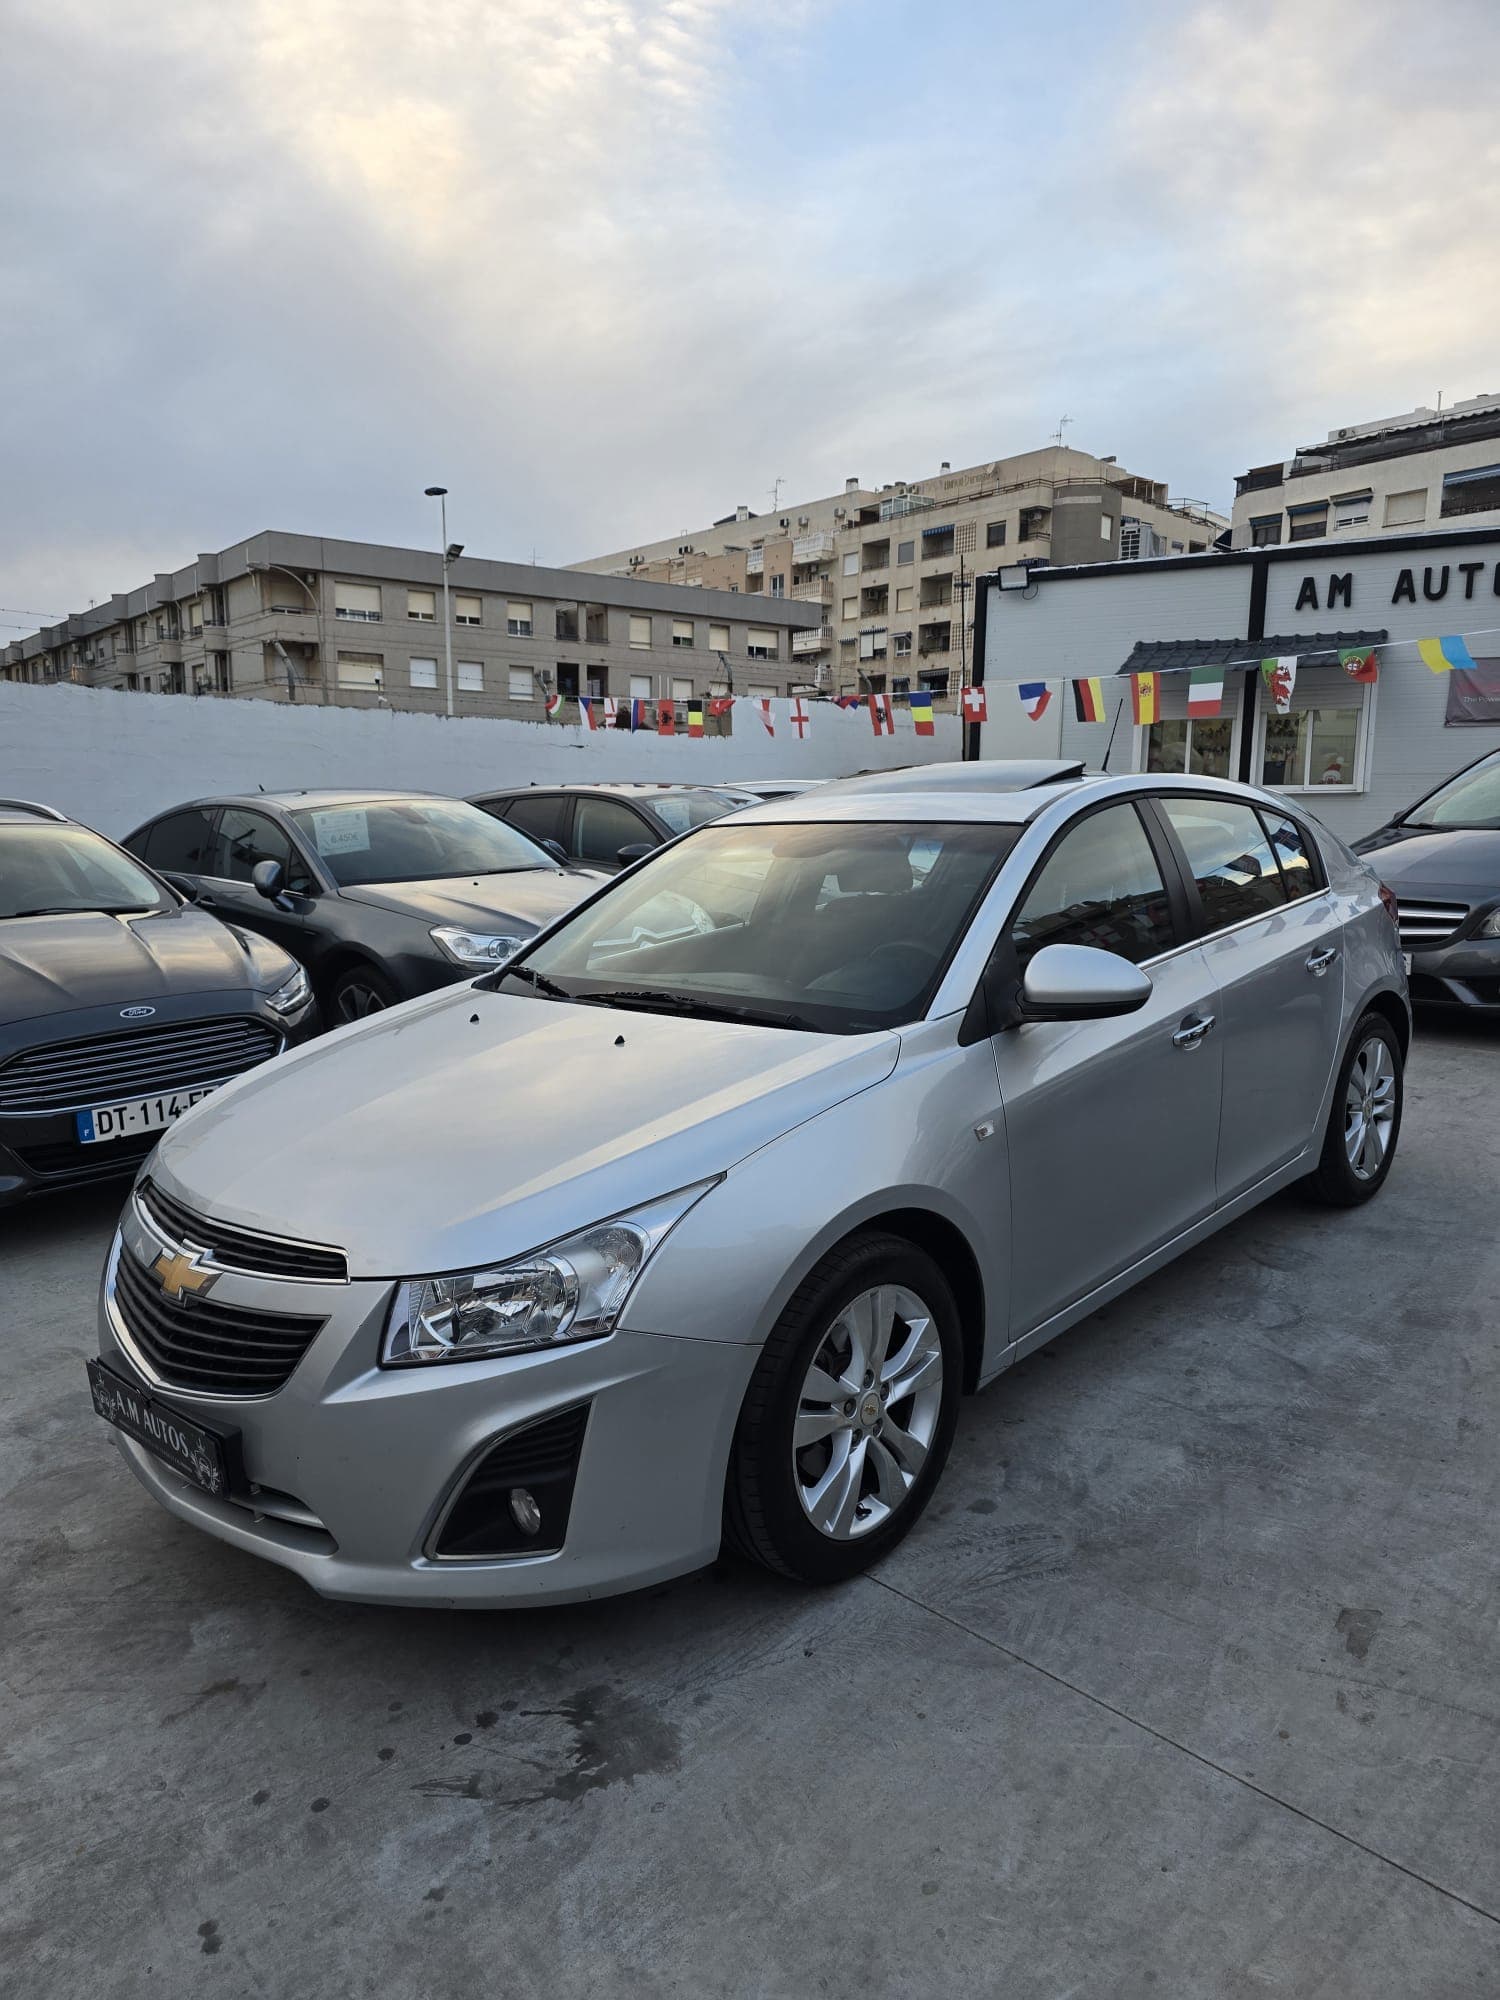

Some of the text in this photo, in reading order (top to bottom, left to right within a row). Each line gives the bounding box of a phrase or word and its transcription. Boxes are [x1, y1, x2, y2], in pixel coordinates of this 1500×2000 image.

[1295, 561, 1500, 611] AM AUT
[143, 1408, 189, 1458] AUTOS
